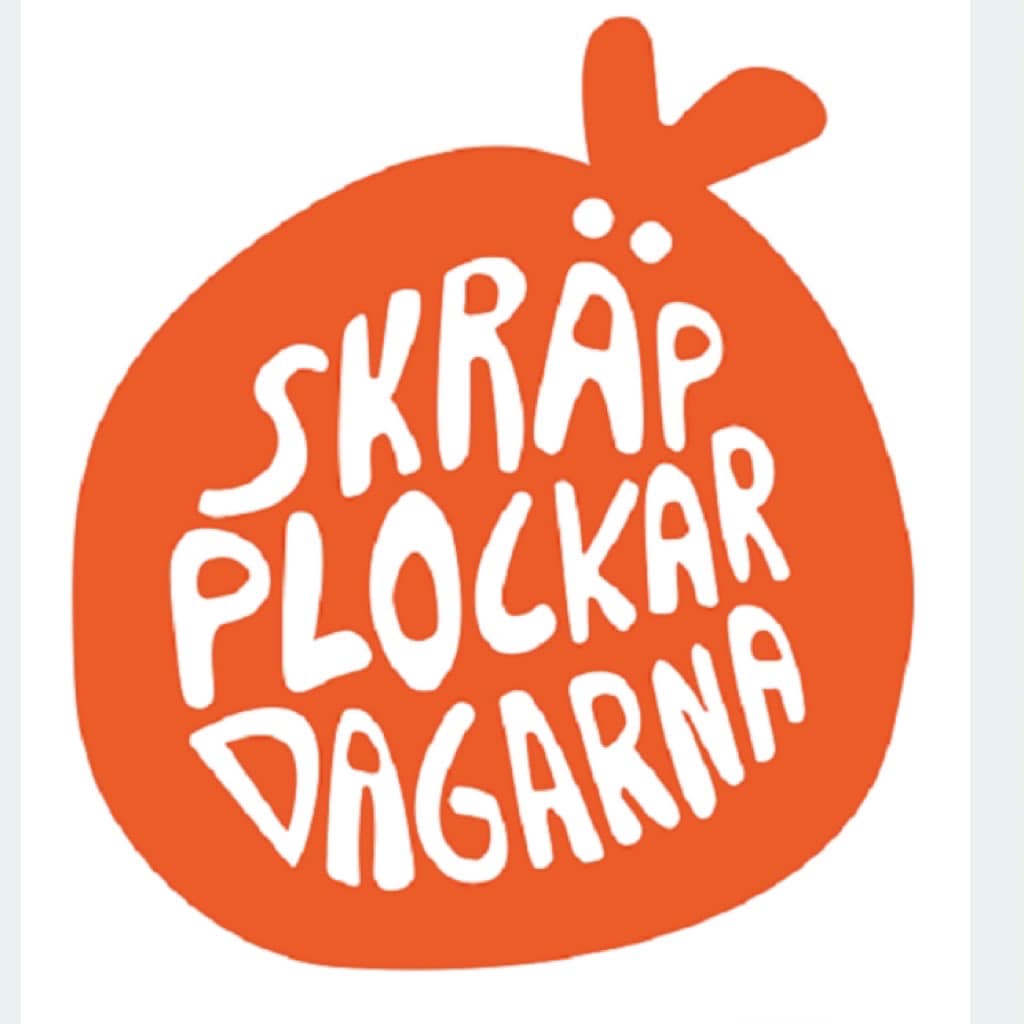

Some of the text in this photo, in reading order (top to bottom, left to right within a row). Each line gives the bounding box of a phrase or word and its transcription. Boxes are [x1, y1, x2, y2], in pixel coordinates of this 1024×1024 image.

[199, 198, 723, 517] SKRÄP
[170, 426, 790, 709] PLOCKAR
[190, 605, 805, 890] DAGARNA
